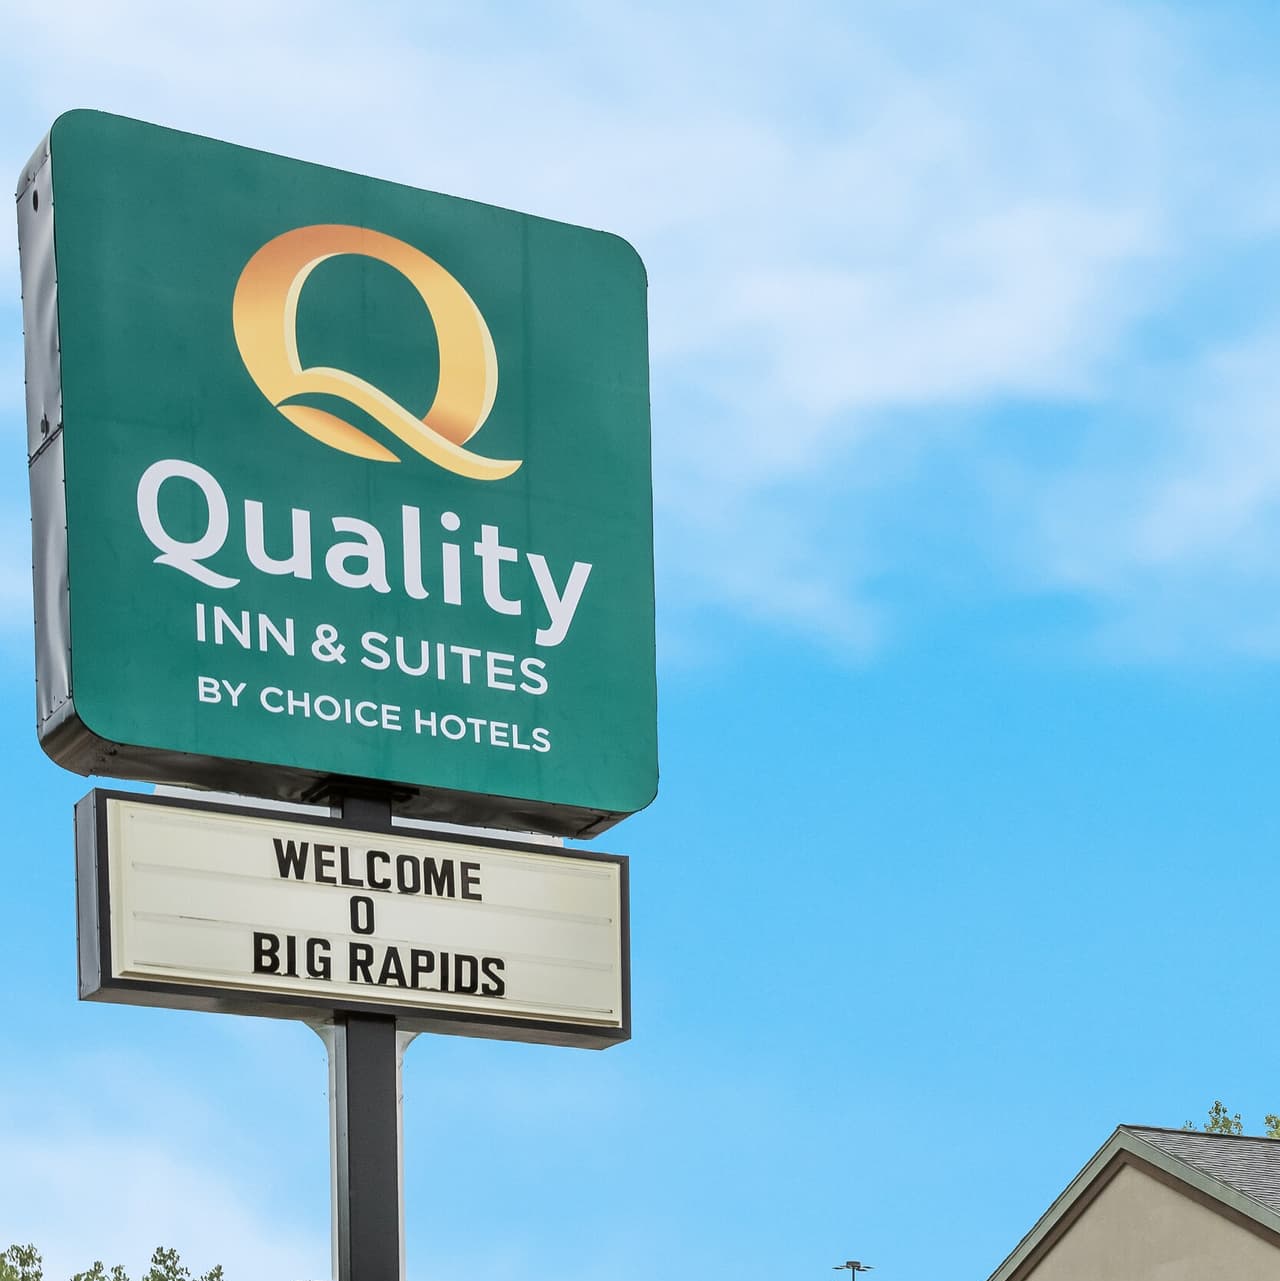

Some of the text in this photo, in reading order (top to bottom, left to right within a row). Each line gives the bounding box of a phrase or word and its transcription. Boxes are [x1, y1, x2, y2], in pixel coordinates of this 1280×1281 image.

[136, 459, 593, 647] Quality
[196, 603, 548, 695] INN & SUITES
[198, 676, 551, 753] BY CHOICE HOTELS
[273, 837, 483, 902] WELCOME
[253, 932, 506, 998] BIG RAPIDS
